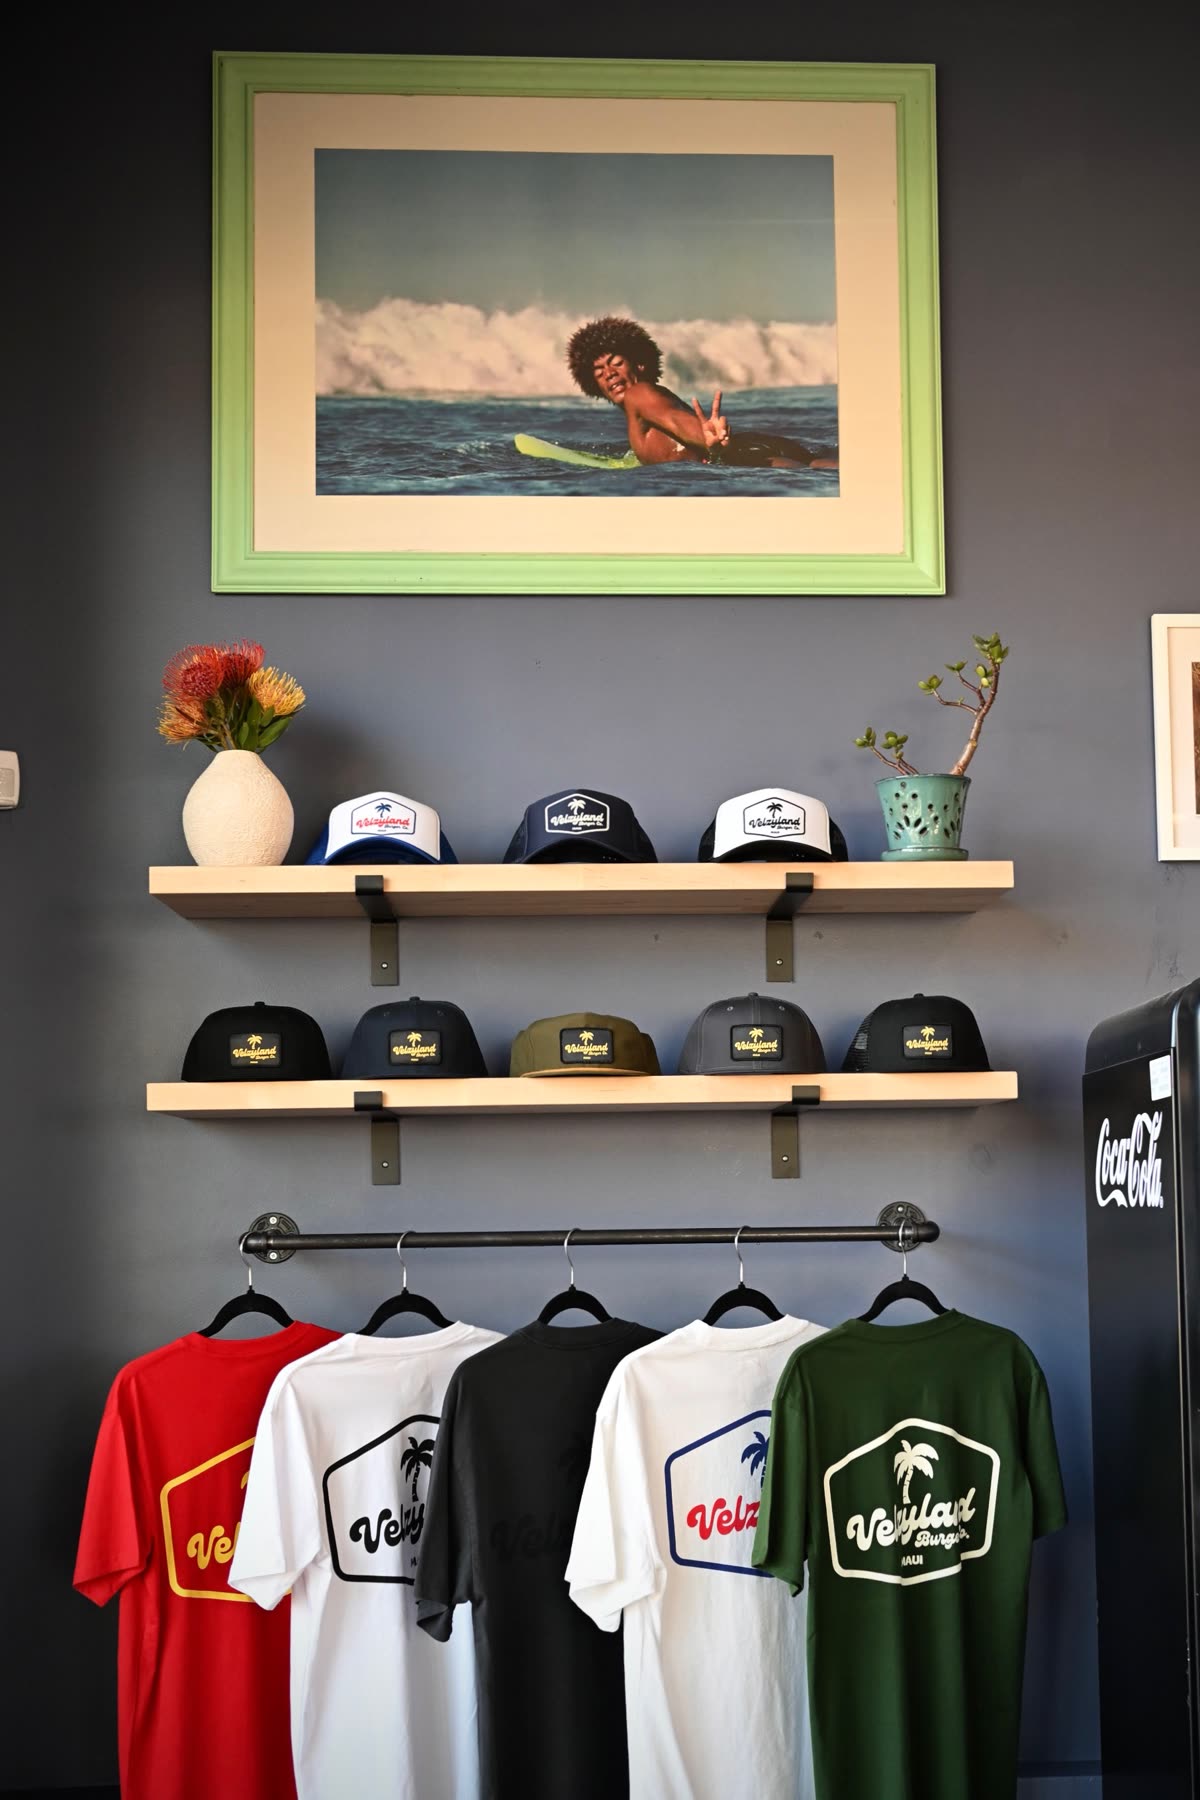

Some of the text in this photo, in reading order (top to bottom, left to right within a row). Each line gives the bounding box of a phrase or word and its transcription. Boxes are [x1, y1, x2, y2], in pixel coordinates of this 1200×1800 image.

[356, 815, 410, 828] Velzyland
[550, 812, 604, 826] Velzyland
[748, 816, 801, 828] Velzyland
[1095, 1111, 1164, 1209] Coca-Cola
[687, 1494, 761, 1541] Velz
